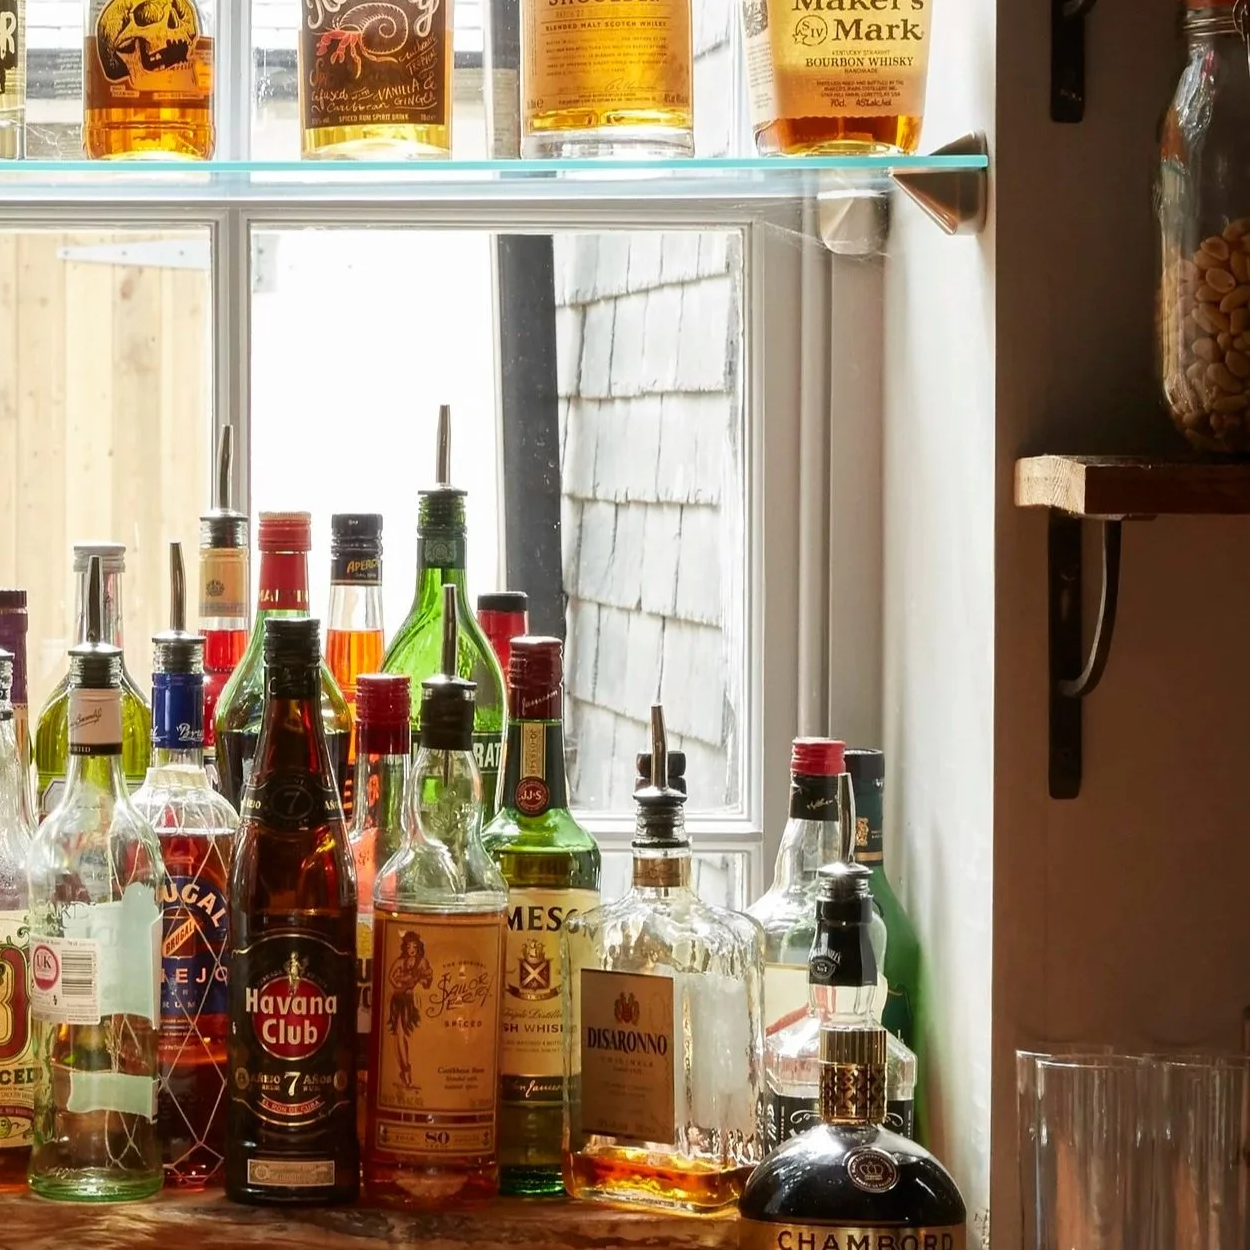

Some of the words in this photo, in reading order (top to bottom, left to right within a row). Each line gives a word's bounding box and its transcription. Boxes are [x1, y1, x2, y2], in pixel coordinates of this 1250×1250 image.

[546, 23, 577, 31] BLENDED
[831, 18, 923, 41] Mark
[806, 57, 865, 67] BOURBON
[869, 56, 914, 66] WHISKY
[338, 115, 357, 123] SPICED
[521, 690, 558, 716] Jameson
[165, 918, 196, 955] BRUGAL
[36, 954, 52, 969] UK
[245, 987, 337, 1015] Havana
[262, 1018, 318, 1045] Club
[586, 1026, 668, 1056] DISARONNO
[470, 1066, 485, 1074] Rum
[250, 1072, 280, 1084] AÑEJO
[284, 1071, 301, 1096] 7
[303, 1072, 332, 1084] AÑOS
[272, 1102, 287, 1111] RON
[301, 1100, 320, 1111] CUBA
[425, 1132, 450, 1145] 80
[777, 1230, 954, 1250] CHAMBORD
